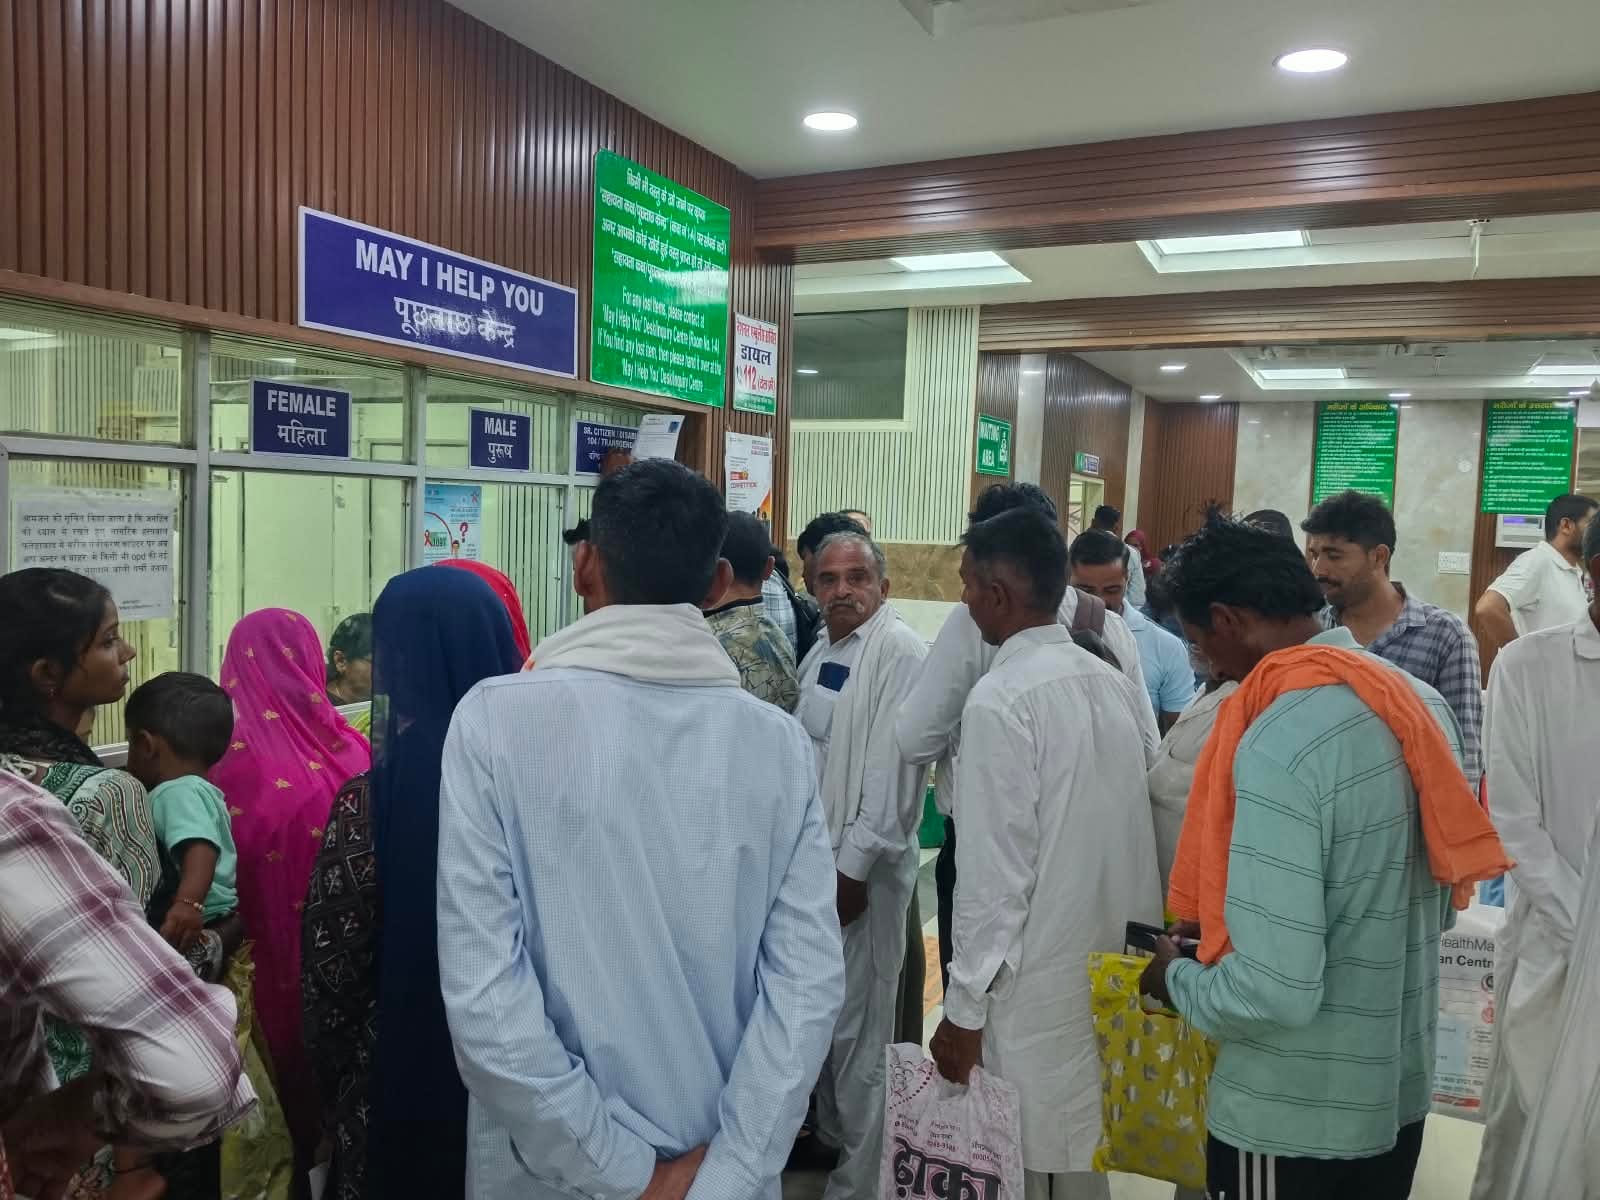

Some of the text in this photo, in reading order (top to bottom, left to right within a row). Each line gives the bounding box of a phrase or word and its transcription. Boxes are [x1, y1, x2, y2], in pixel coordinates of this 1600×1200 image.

[355, 239, 544, 316] MAY I HELP YOU
[394, 297, 471, 338] पूछताछ
[623, 286, 632, 305] For
[632, 293, 641, 313] any
[667, 303, 682, 322] please
[741, 344, 772, 366] डायल
[744, 364, 757, 390] 112
[267, 389, 336, 417] FEMALE
[277, 419, 328, 448] महिला
[484, 416, 517, 437] MALE
[594, 428, 616, 438] CITIZEN
[132, 552, 145, 561] opd
